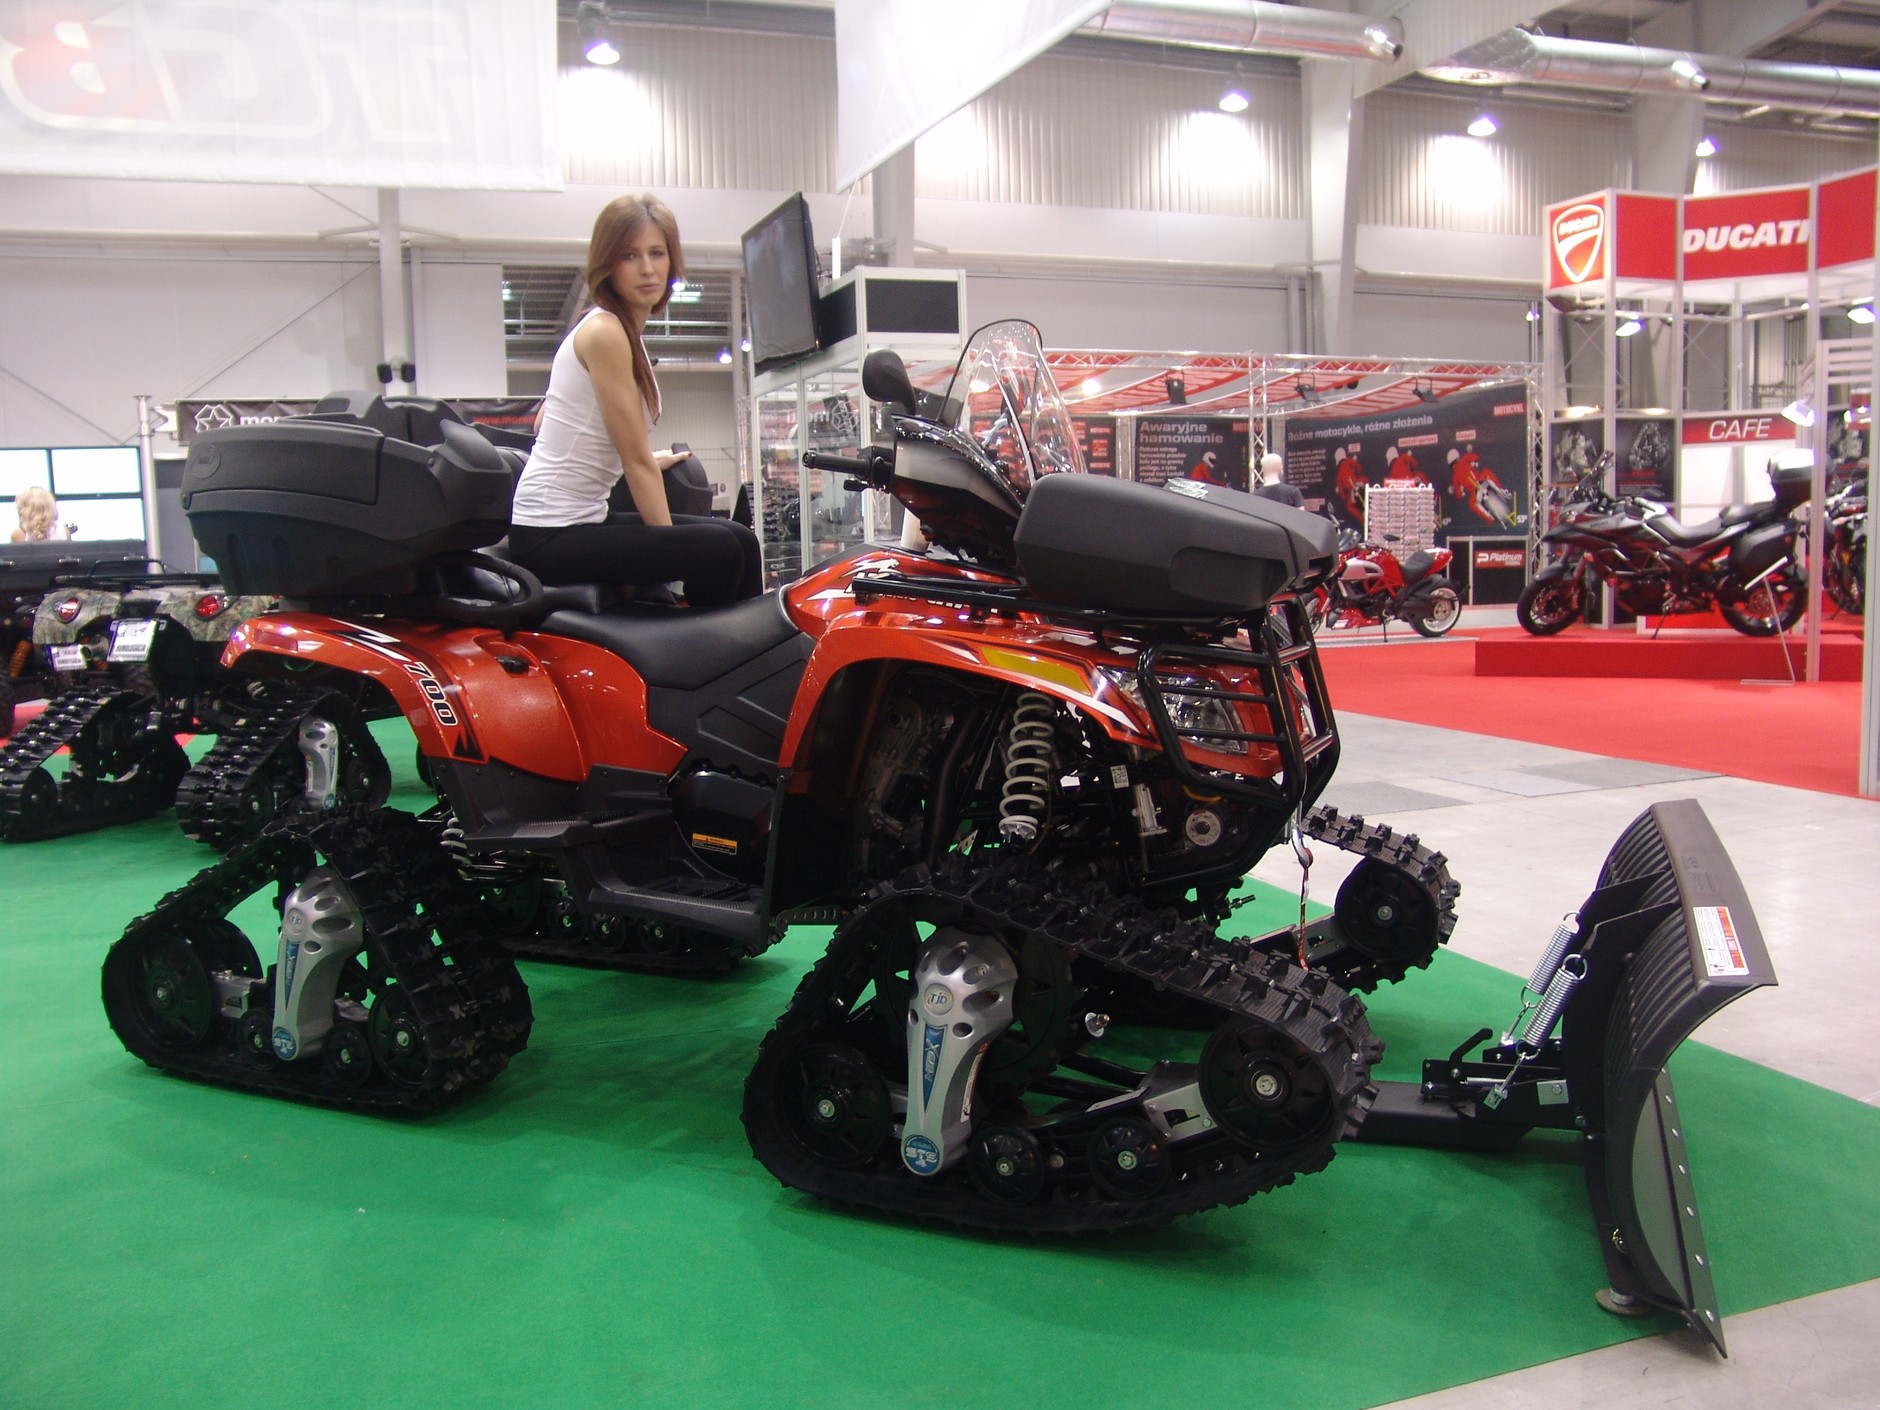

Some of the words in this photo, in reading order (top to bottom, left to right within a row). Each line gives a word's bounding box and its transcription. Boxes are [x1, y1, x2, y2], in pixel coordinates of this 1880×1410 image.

[1683, 219, 1810, 254] DUCATI
[1140, 421, 1207, 434] Awaryjne
[1140, 433, 1223, 444] hamowanie
[1287, 429, 1313, 442] Różne
[1315, 425, 1363, 439] motocykle,
[1365, 421, 1390, 434] różne
[1393, 414, 1433, 429] złożenia
[1708, 417, 1773, 440] CAFE
[1490, 552, 1522, 562] Platinum
[403, 661, 458, 726] 700
